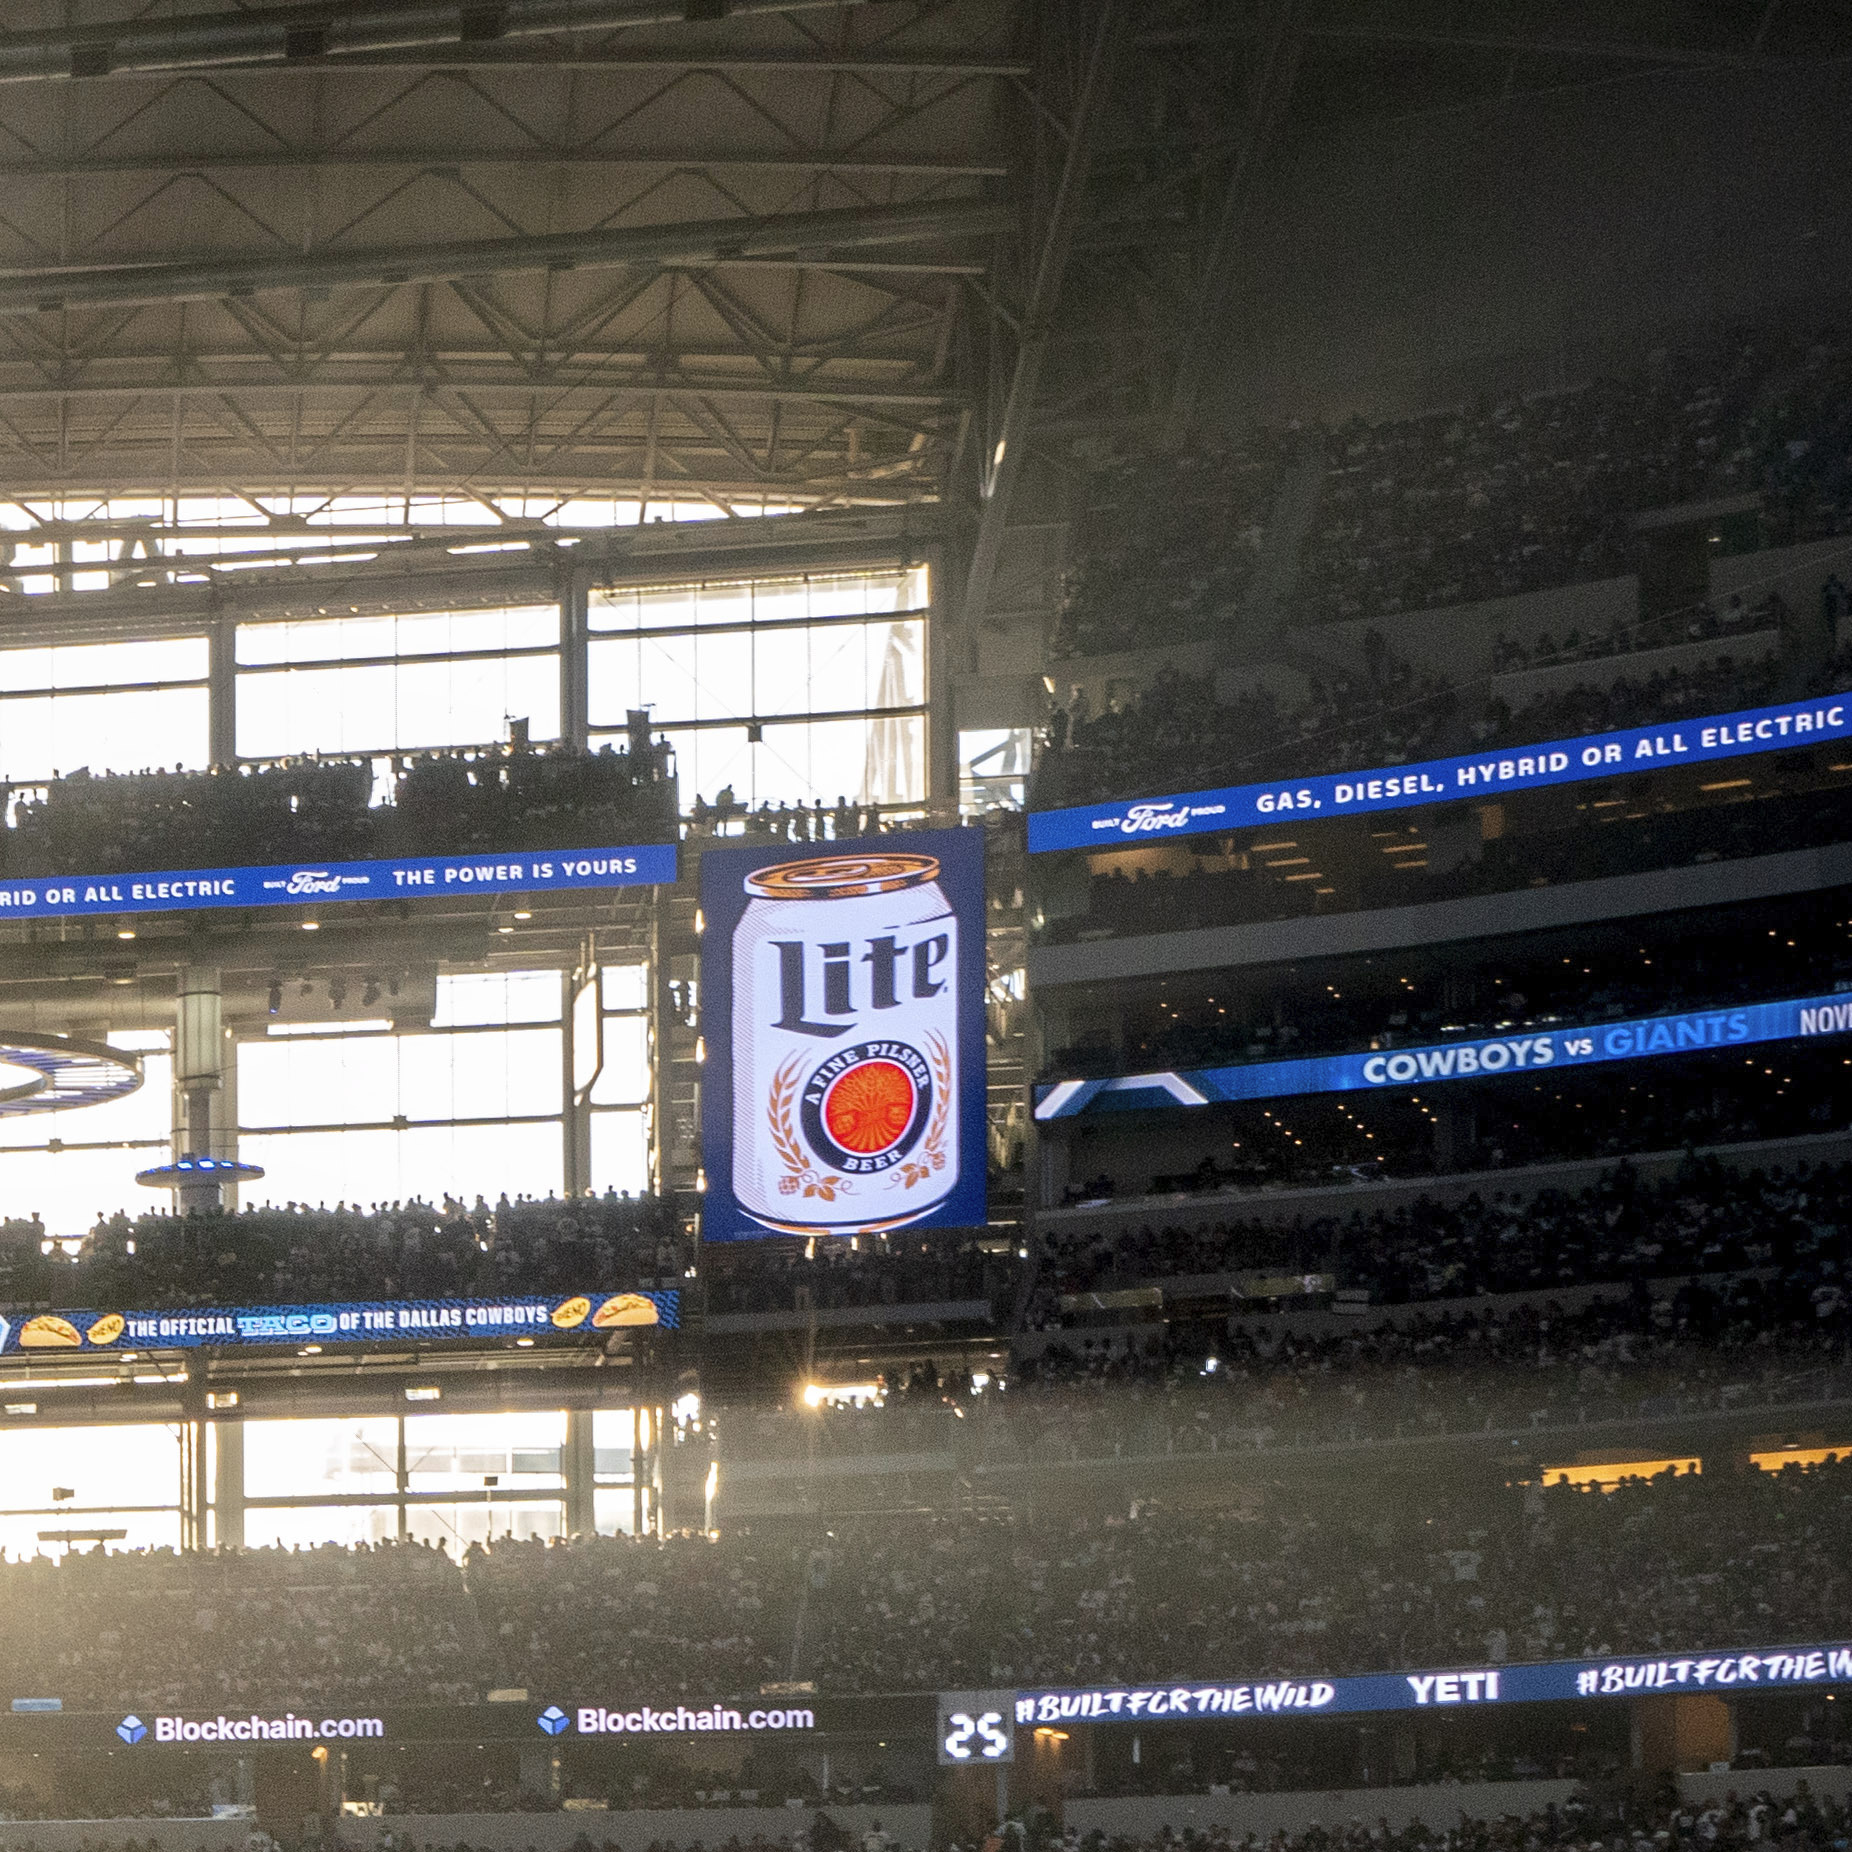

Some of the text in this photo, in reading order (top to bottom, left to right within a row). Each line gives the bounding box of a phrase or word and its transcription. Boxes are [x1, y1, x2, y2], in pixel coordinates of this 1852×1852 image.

[1256, 706, 1844, 813] GAS, DIESEL, HYBRID OR ALL ELECTRIC
[1120, 802, 1190, 834] Ford
[286, 871, 342, 895] Ford
[392, 858, 637, 886] THE POWER IS YOURS
[45, 887, 76, 904] OR
[84, 885, 123, 902] ALL
[131, 879, 235, 900] ELECTRIC
[768, 933, 949, 1038] Lite
[1362, 1035, 1555, 1086] COWBOYS
[1603, 1012, 1749, 1058] GIANTS
[811, 1043, 931, 1092] FINE PILSNER
[842, 1150, 904, 1171] BEER
[127, 1320, 158, 1337] THE
[160, 1317, 236, 1337] OFFICIAL
[237, 1314, 339, 1336] TACO
[339, 1313, 360, 1331] OF
[362, 1311, 394, 1330] THE
[398, 1308, 462, 1329] DALLAS
[465, 1304, 548, 1327] COWBOYS
[1406, 1671, 1499, 1704] YETI
[155, 1713, 383, 1742] Blockchain.com
[577, 1704, 814, 1733] Blockchain.com
[945, 1712, 1008, 1758] 25
